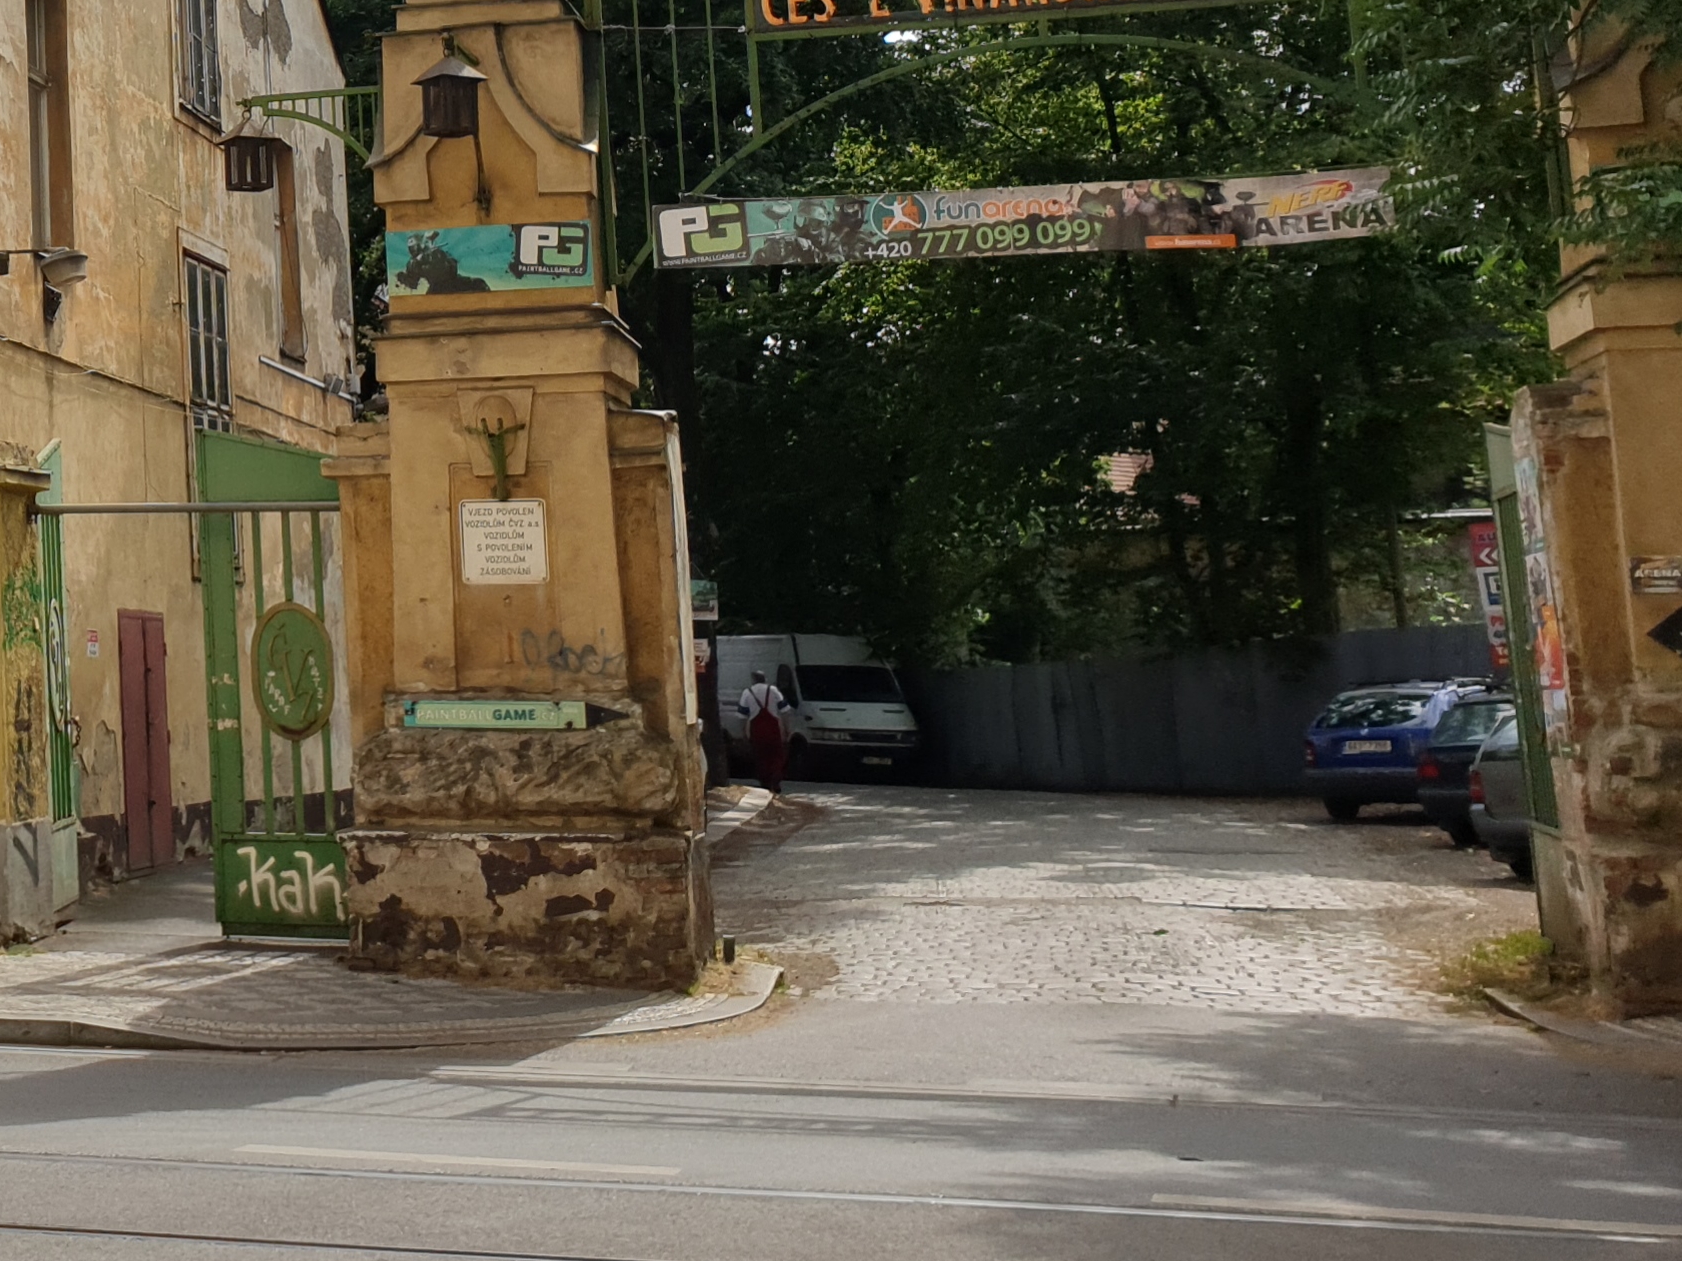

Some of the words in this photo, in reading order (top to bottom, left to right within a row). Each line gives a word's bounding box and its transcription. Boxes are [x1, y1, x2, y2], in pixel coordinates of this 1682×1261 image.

[933, 195, 1066, 220] funarena
[1254, 203, 1389, 238] ARENA
[863, 241, 912, 259] +420
[919, 230, 968, 255] 777
[976, 224, 1030, 250] 099
[1036, 218, 1091, 245] 099
[468, 508, 493, 516] VJEZD
[496, 507, 534, 516] POVOLEN
[465, 518, 505, 528] VOZIDLŮM
[508, 518, 524, 527] ČVZ
[484, 529, 524, 539] VOZIDLŮM
[476, 544, 482, 552] S
[485, 543, 533, 551] POVOLENÍM
[485, 553, 526, 563] VOZIDLŮM
[480, 566, 531, 575] ZÁSOBOVÁNÍ
